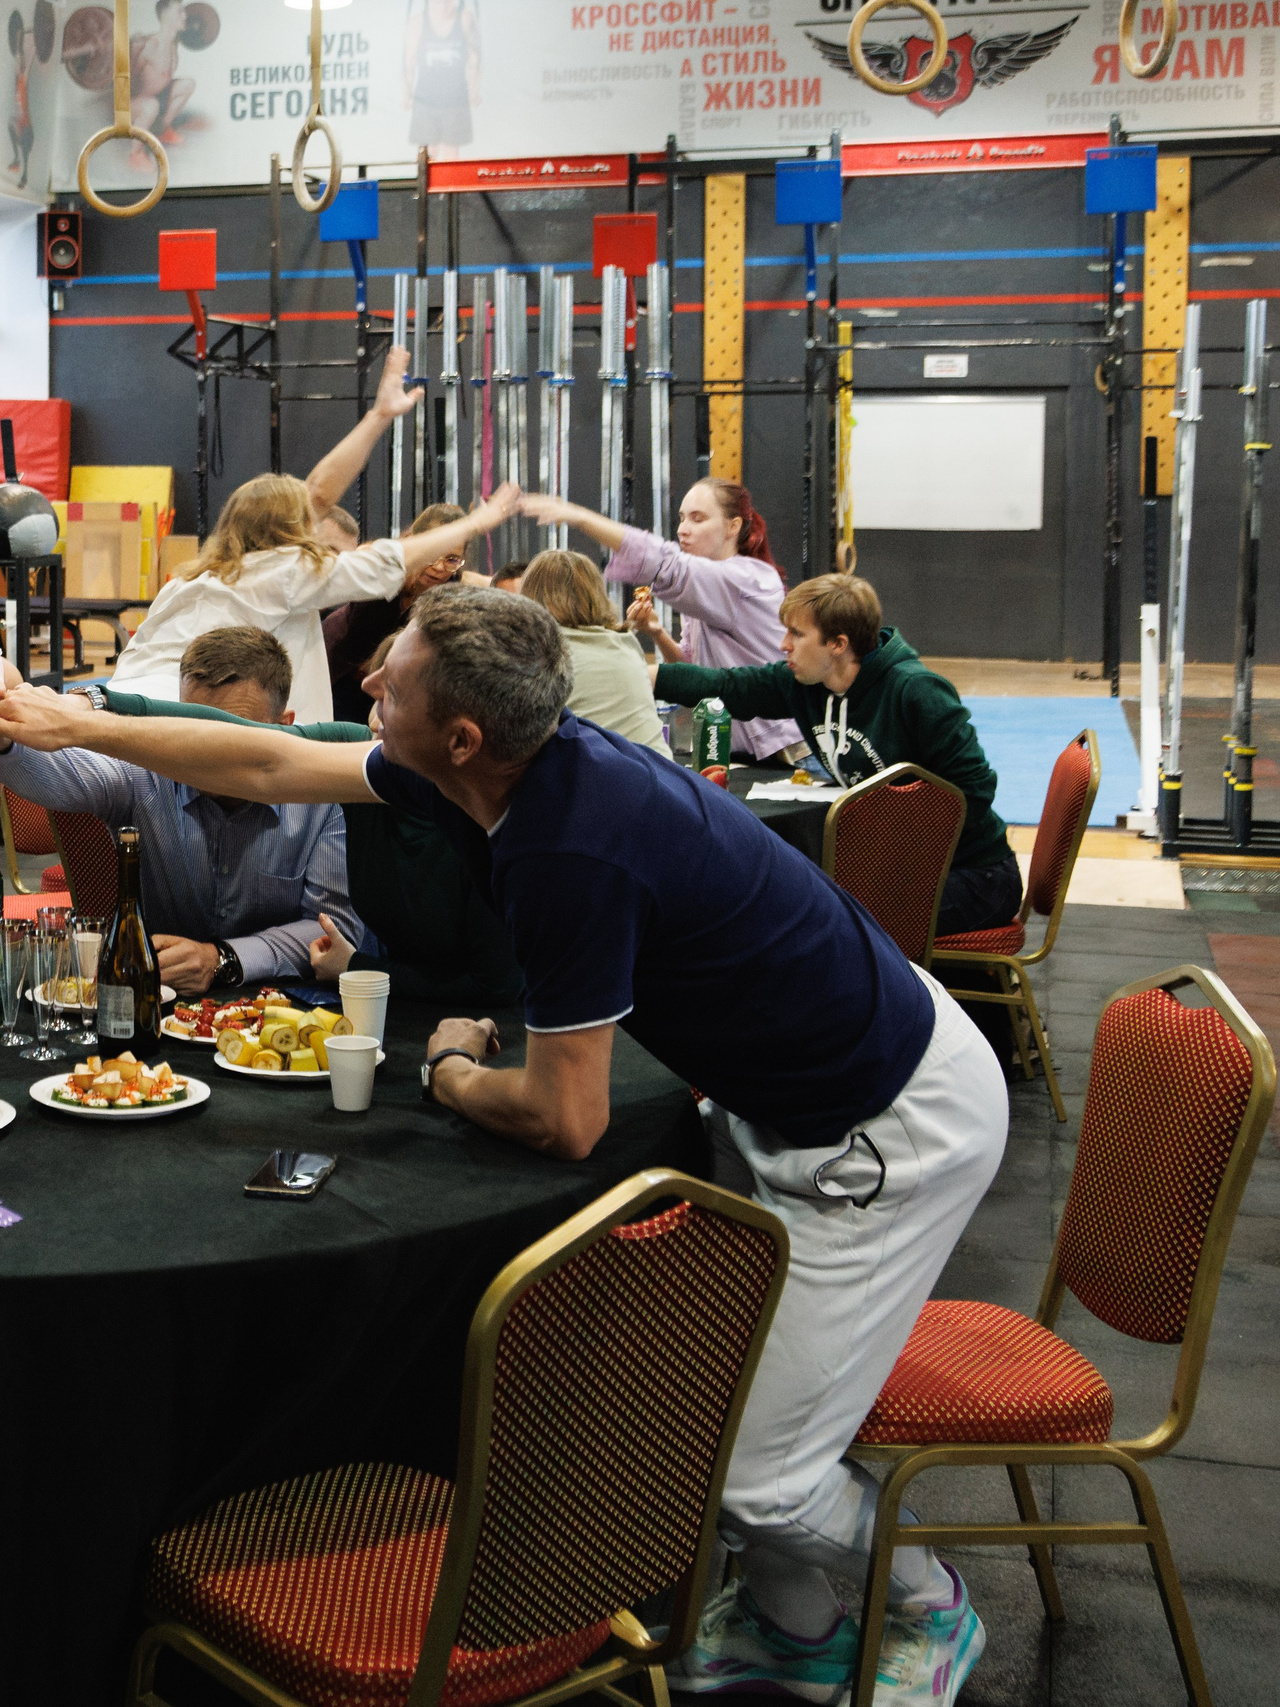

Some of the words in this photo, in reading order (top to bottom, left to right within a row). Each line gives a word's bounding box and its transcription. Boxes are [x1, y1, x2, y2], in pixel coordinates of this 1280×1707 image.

[572, 0, 718, 30] КРОССФИТ
[307, 32, 369, 58] УДЬ
[609, 33, 634, 52] НЕ
[230, 61, 369, 86] ВЕЛИКОЕПЕН
[680, 58, 694, 78] А
[701, 50, 787, 77] СТИЛЬ
[1091, 43, 1120, 85] Я
[703, 77, 823, 112] ЖИЗНИ
[706, 725, 719, 761] Добрый
